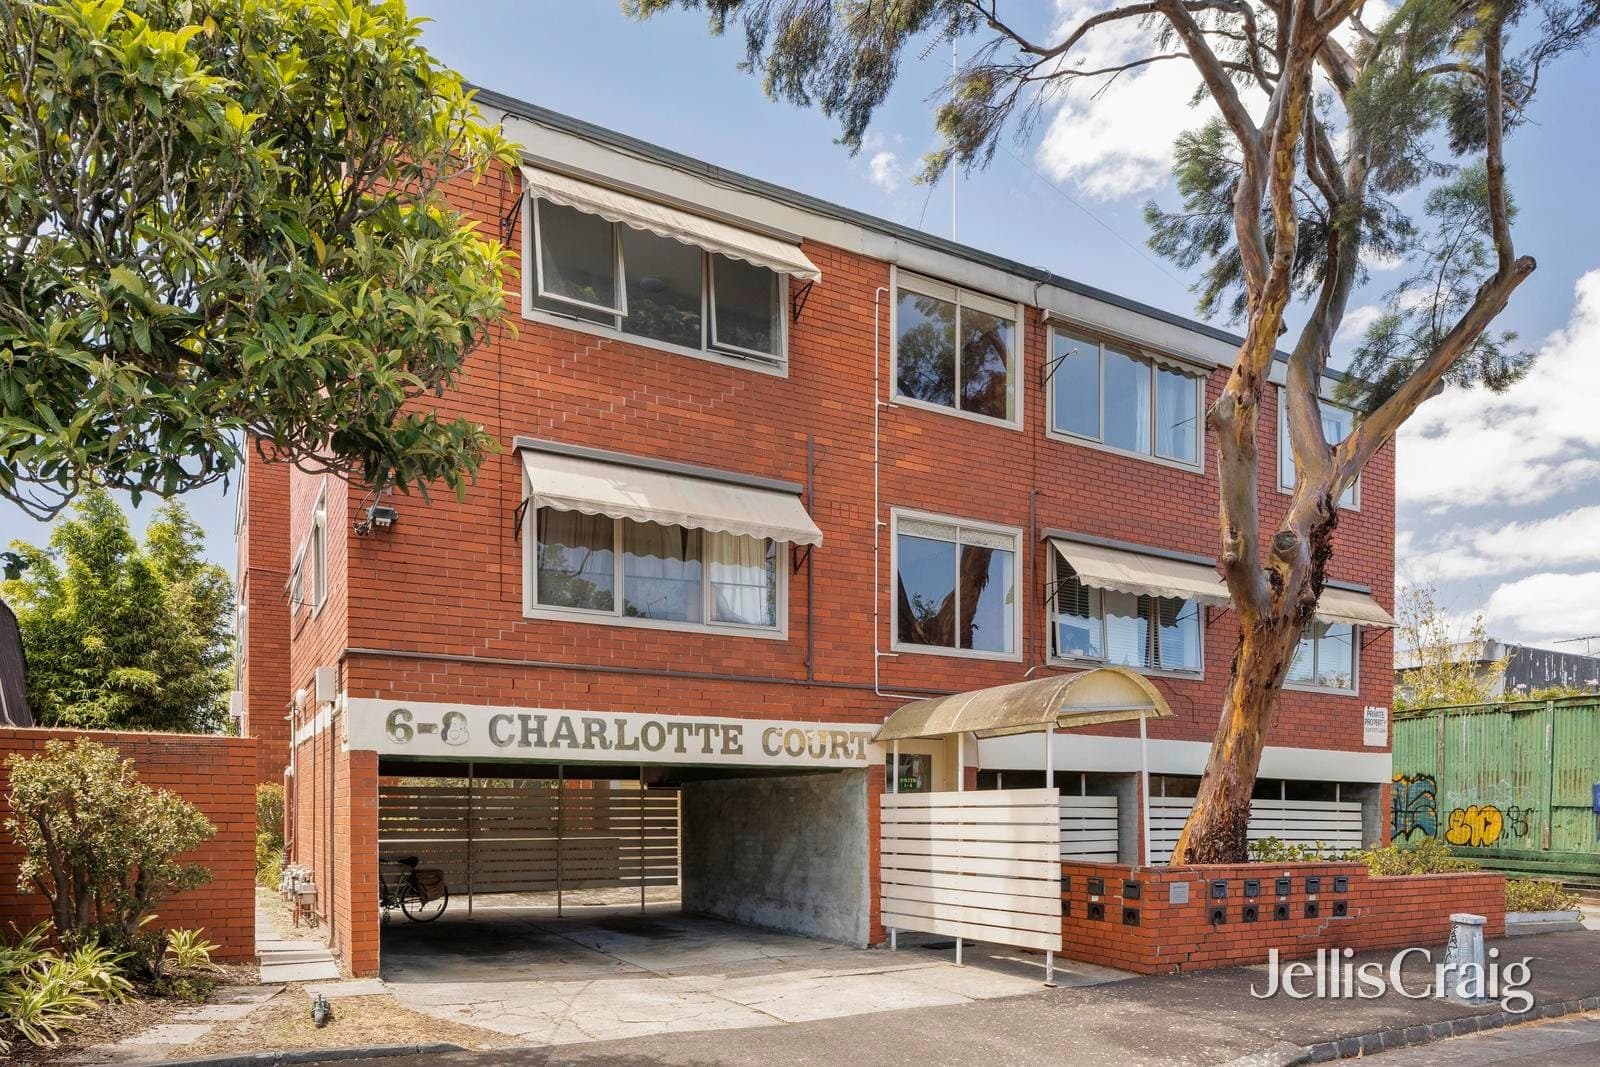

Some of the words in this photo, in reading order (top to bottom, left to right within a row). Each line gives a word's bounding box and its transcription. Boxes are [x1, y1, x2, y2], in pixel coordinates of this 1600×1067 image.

[385, 708, 470, 746] 6-8
[488, 713, 744, 755] CHARLOTTE
[761, 726, 873, 760] COURT
